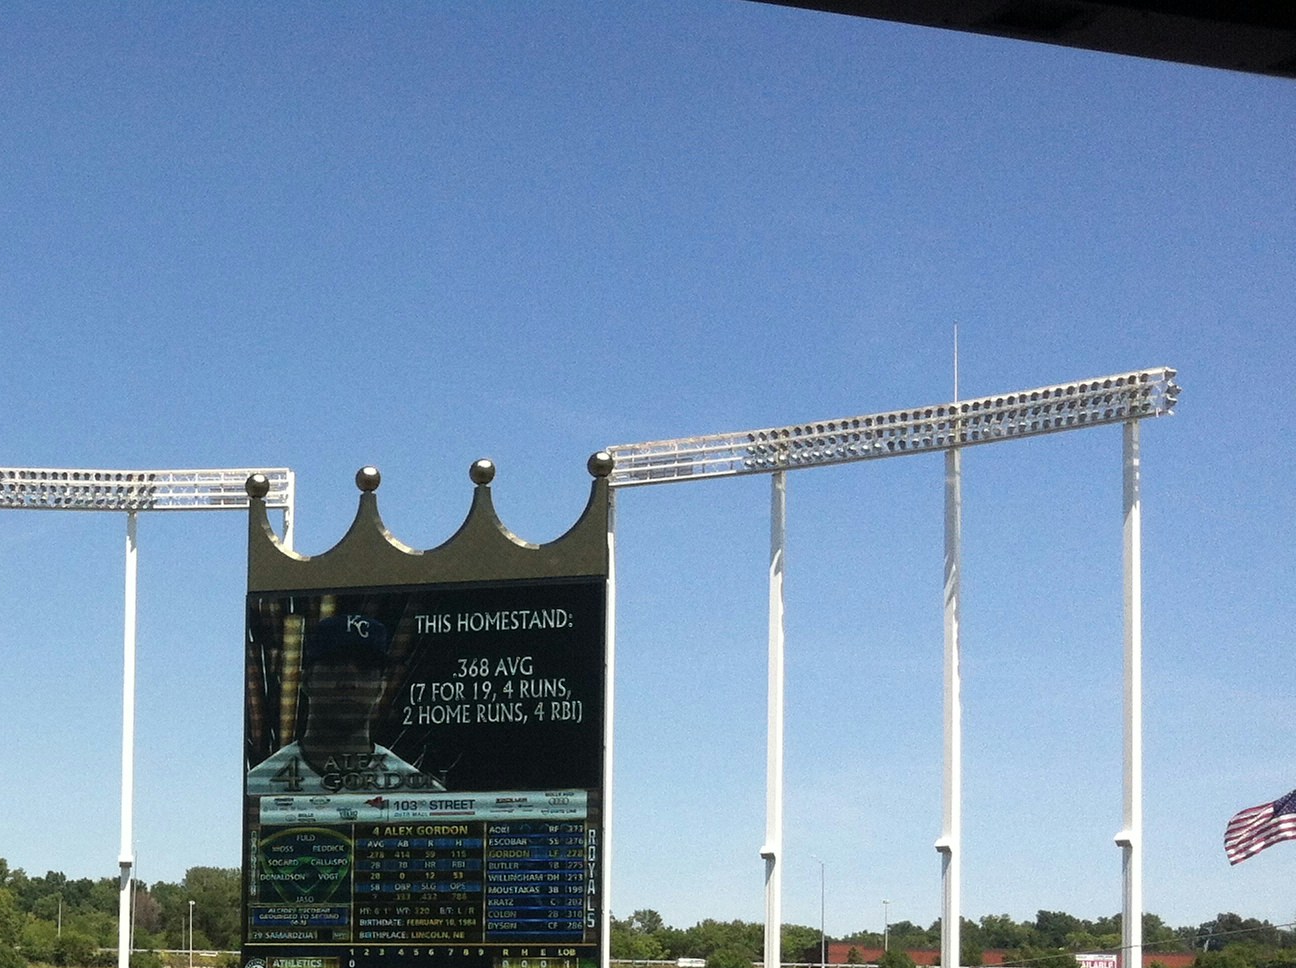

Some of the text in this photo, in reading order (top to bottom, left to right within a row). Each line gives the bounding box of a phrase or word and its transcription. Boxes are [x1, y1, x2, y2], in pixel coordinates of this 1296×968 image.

[415, 609, 573, 633] THIS HOMESTAND:
[452, 656, 533, 678] .368 AVG
[410, 678, 571, 705] (7 FOR 19, 4 RUNS,
[403, 700, 583, 725] 2 HOME RUNS, 4 RBI)
[324, 754, 389, 772] ALEX
[270, 756, 304, 792] 4
[321, 770, 448, 792] GORDON
[429, 799, 476, 810] STREET
[373, 825, 468, 836] 4 ALEX GORDON
[489, 826, 510, 834] AOKI
[397, 840, 409, 848] AB
[489, 838, 527, 846] ESCOBAR
[489, 850, 530, 858] GORDON
[488, 886, 540, 894] MOUSTAKAS
[488, 898, 514, 906] KRATZ
[272, 959, 322, 968] ATHLETICS
